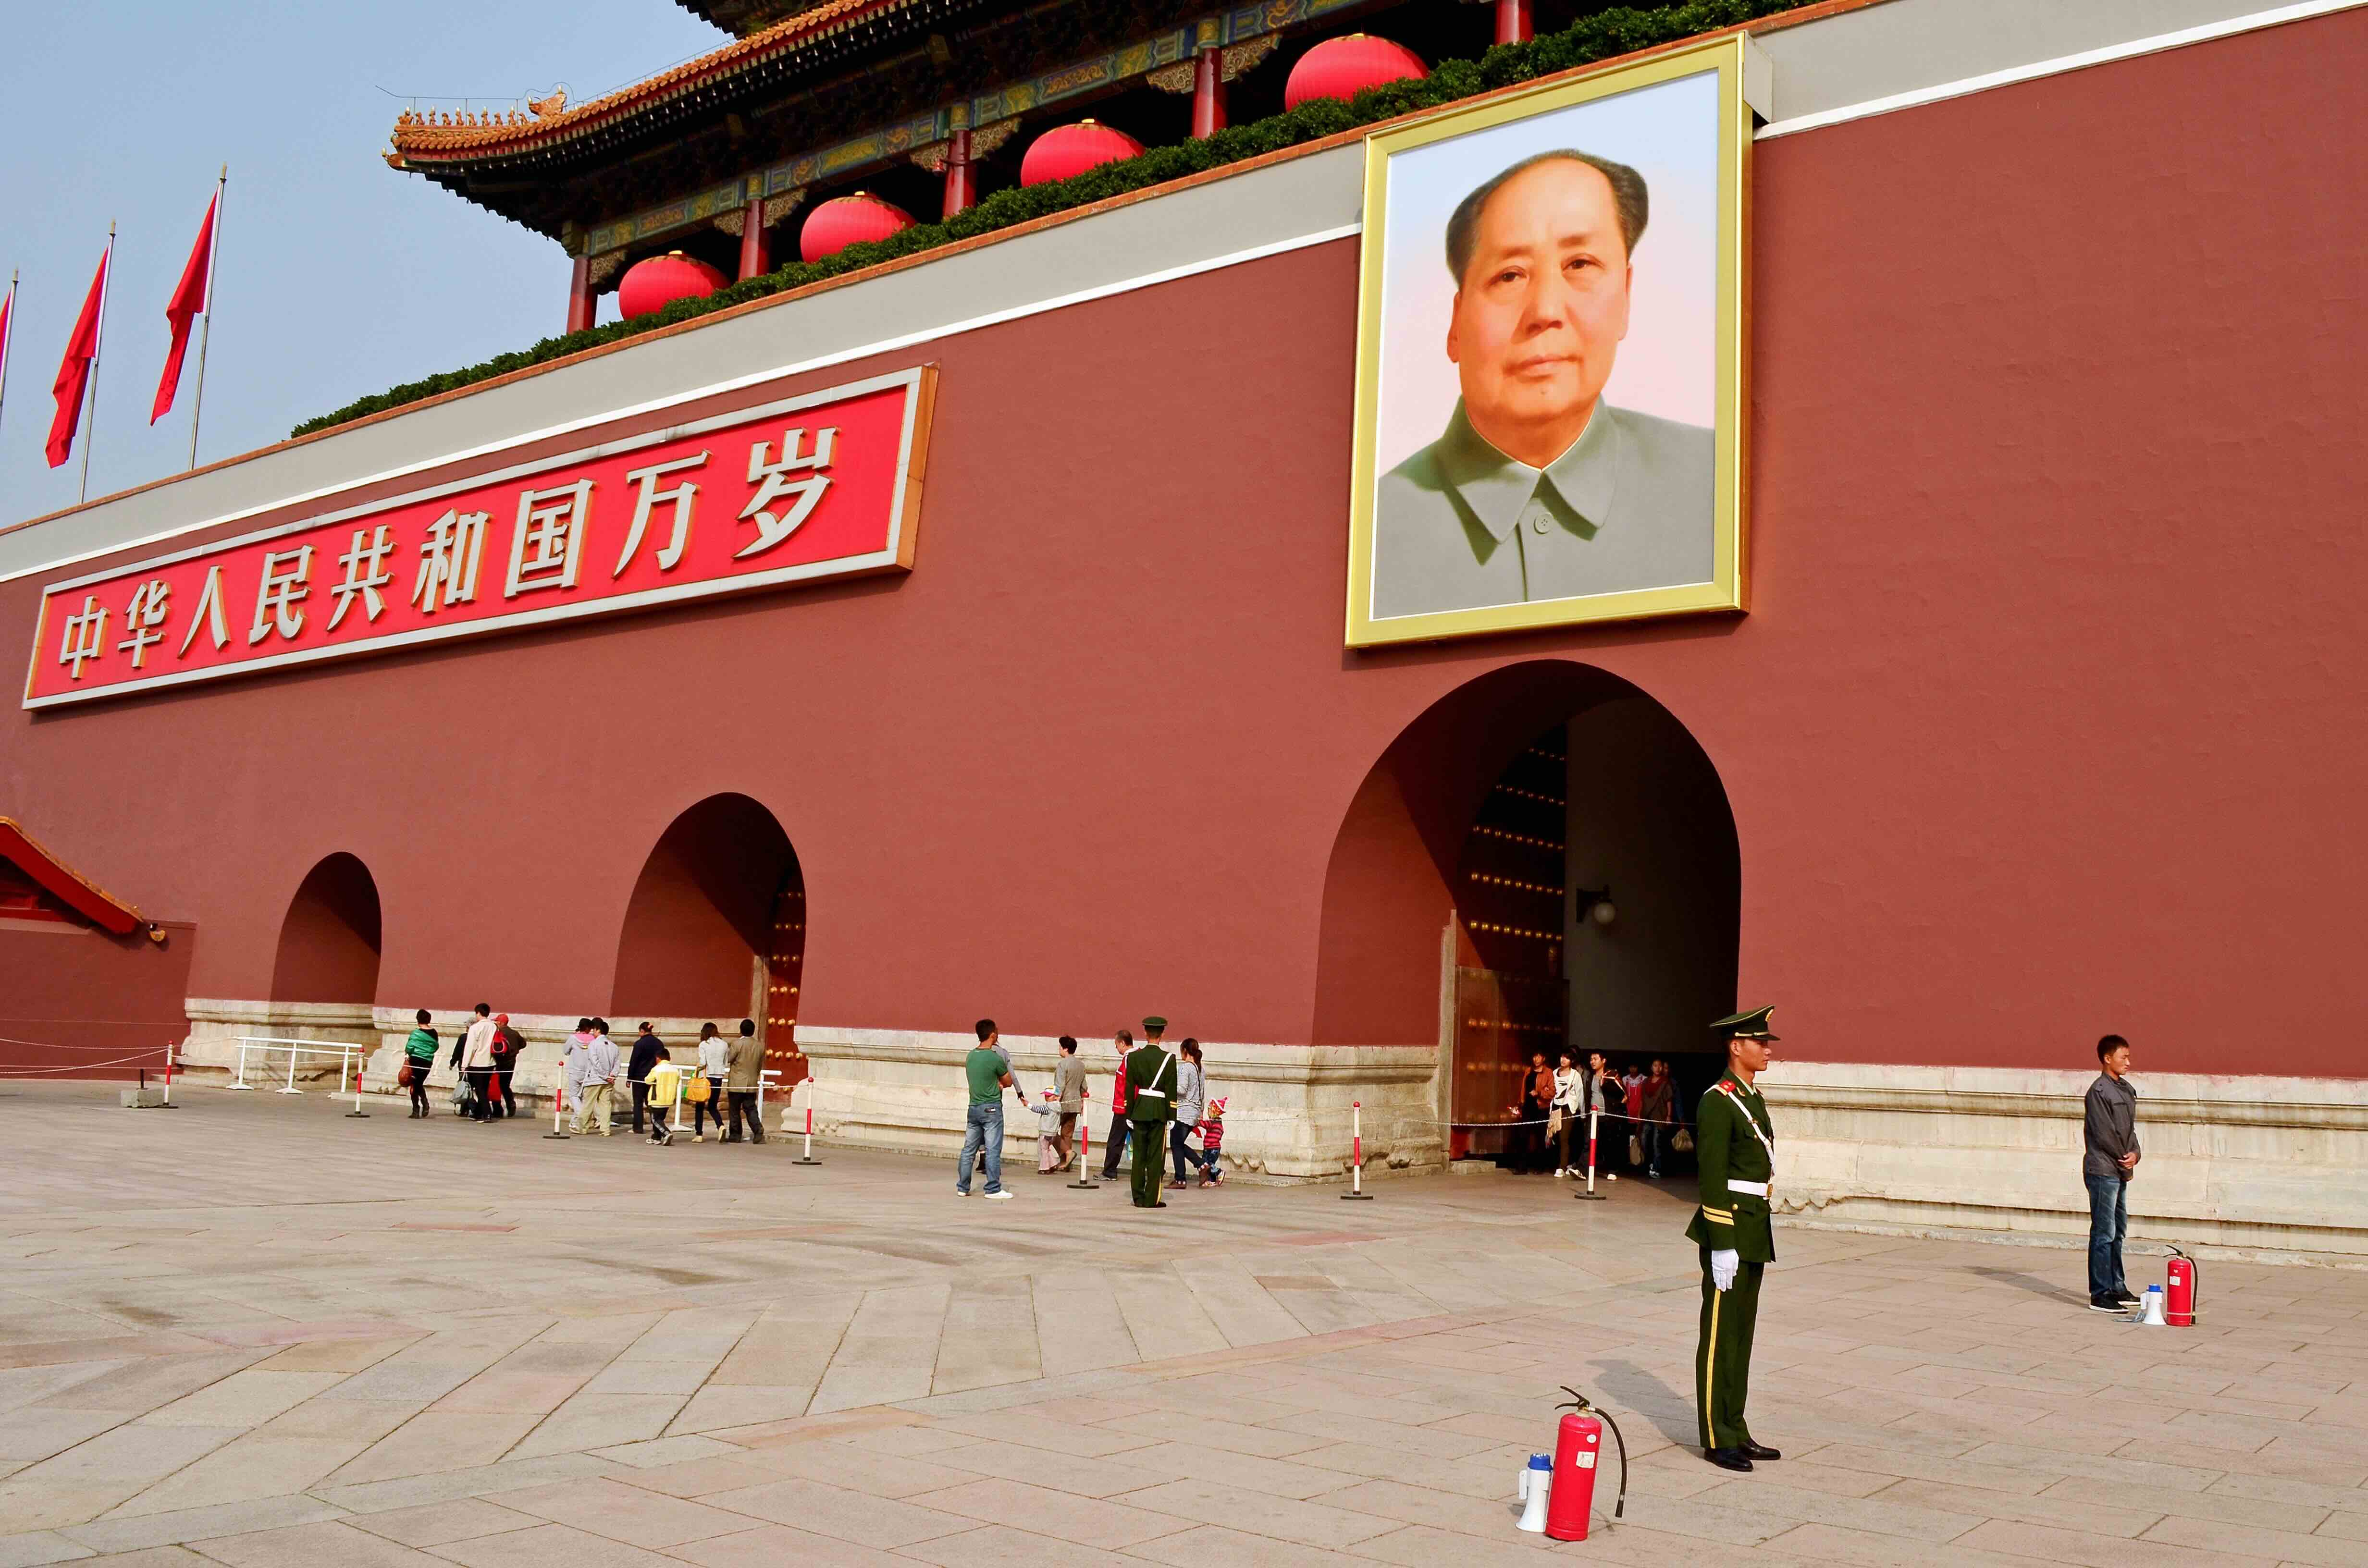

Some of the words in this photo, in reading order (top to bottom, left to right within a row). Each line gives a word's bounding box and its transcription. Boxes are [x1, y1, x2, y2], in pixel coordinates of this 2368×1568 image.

[59, 427, 839, 679] 中华人民共和国万岁
